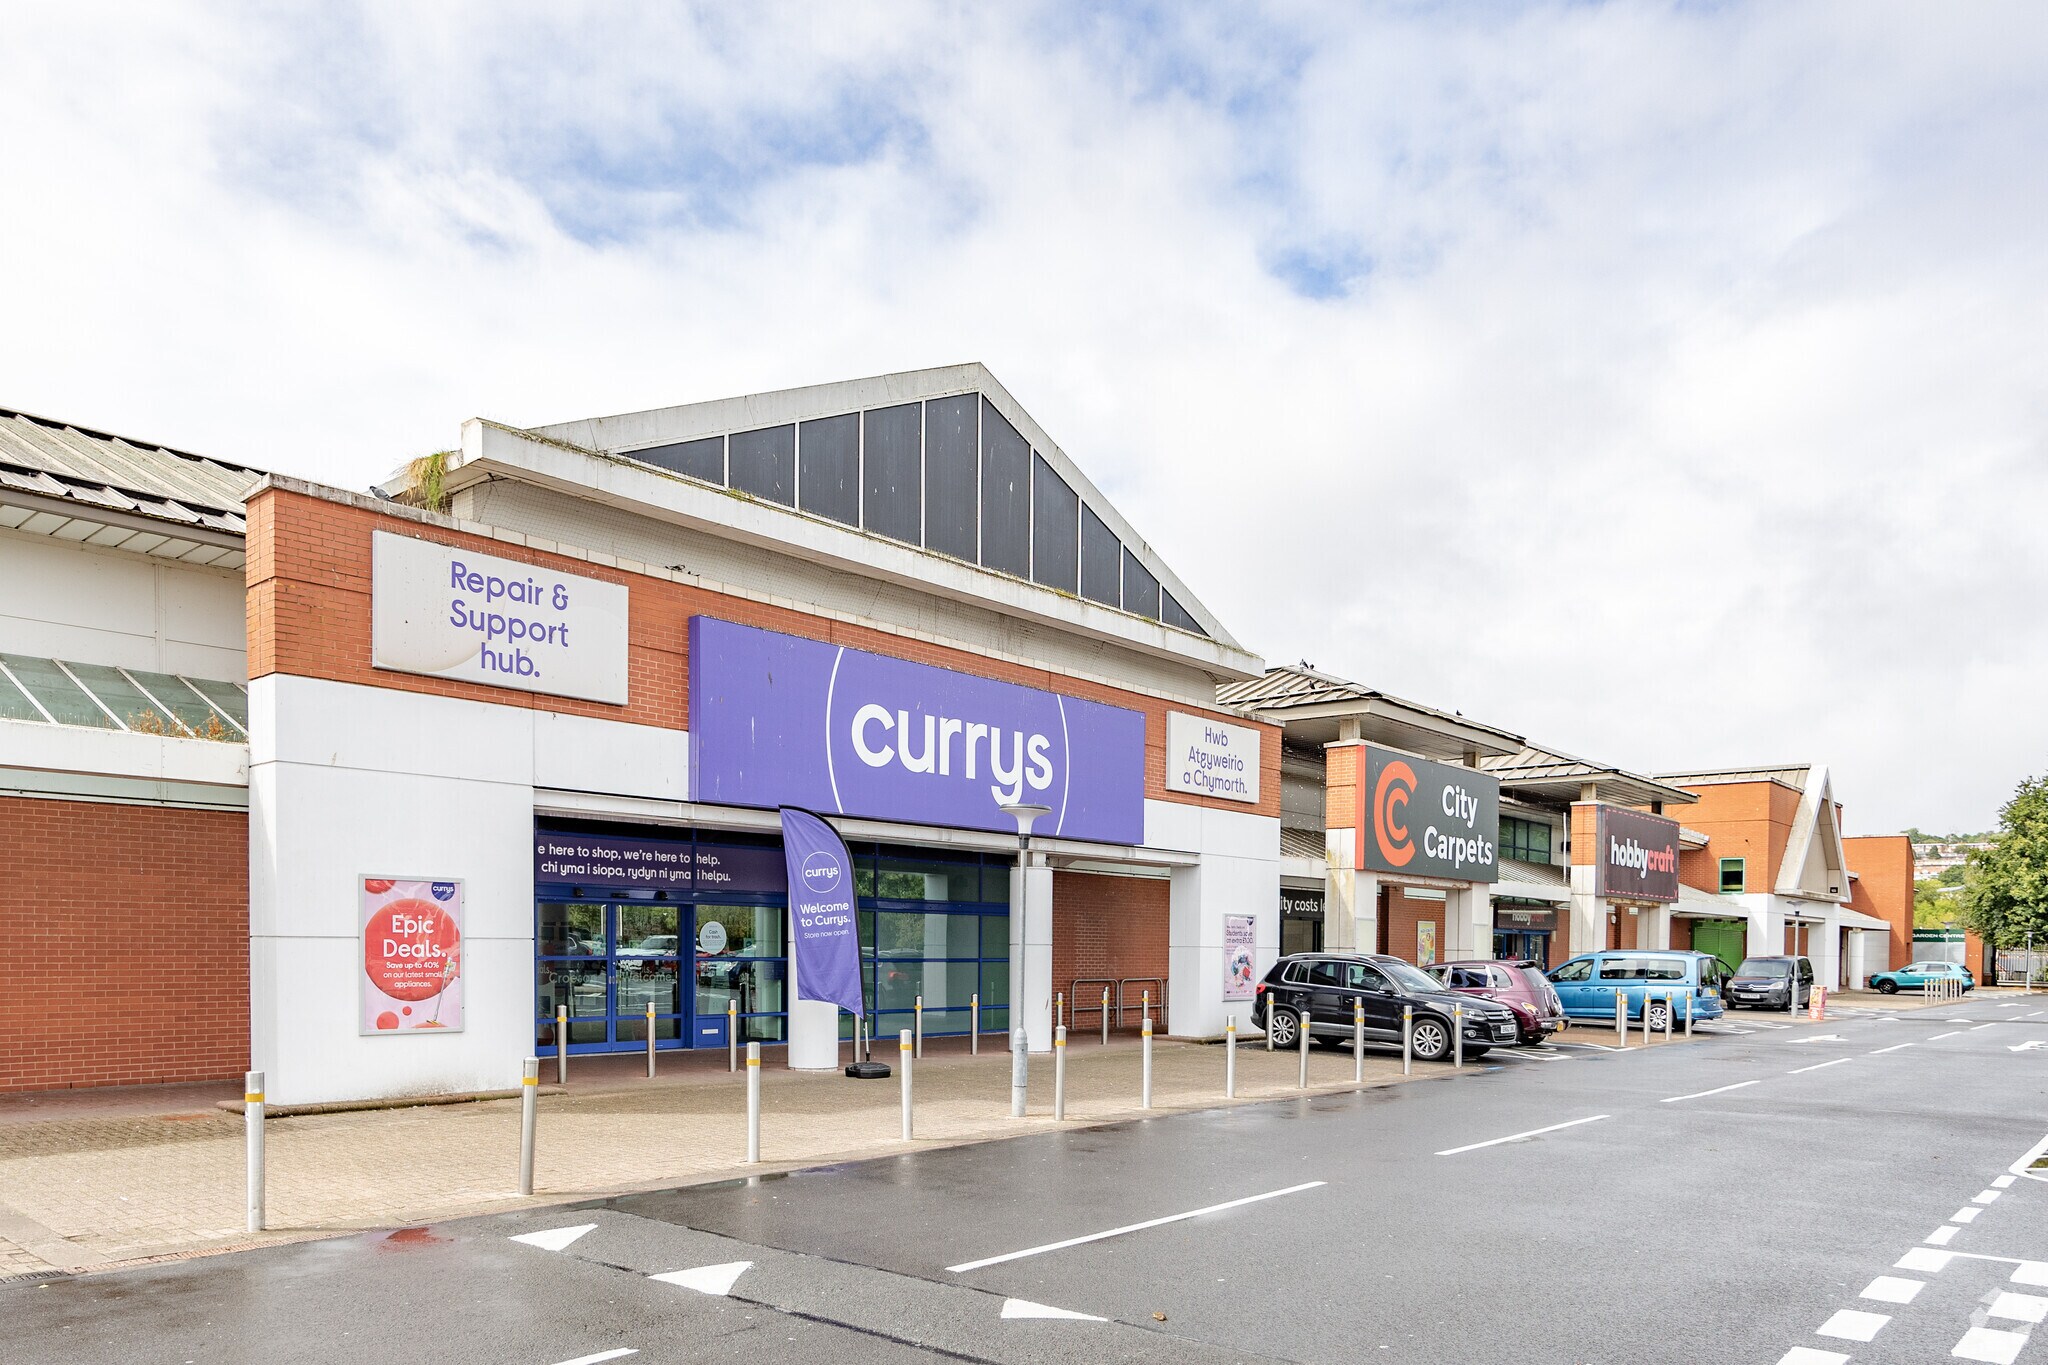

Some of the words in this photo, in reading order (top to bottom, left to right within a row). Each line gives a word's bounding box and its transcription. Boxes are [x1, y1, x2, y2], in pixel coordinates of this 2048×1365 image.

[451, 561, 544, 605] Repair
[552, 583, 569, 611] &
[450, 599, 569, 648] Support
[481, 642, 540, 678] hub.
[1204, 726, 1228, 747] Hwb
[851, 703, 1054, 806] currys
[1188, 745, 1243, 772] Atgyweirio
[1183, 771, 1191, 785] a
[1193, 769, 1248, 794] Chymorth.
[1442, 784, 1478, 829] City
[549, 843, 575, 857] here
[577, 846, 589, 857] to
[591, 847, 622, 862] shop,
[623, 849, 652, 861] we're
[655, 850, 678, 863] here
[679, 853, 691, 863] to
[696, 853, 721, 866] help.
[1424, 825, 1493, 869] Carpets
[1610, 834, 1675, 879] hobbycraft
[541, 861, 558, 873] chi
[560, 865, 585, 877] yma
[587, 863, 591, 874] i
[592, 864, 626, 879] siopa,
[627, 866, 657, 880] rydyn
[659, 868, 668, 879] ni
[669, 870, 691, 882] yma
[696, 869, 700, 880] i
[701, 870, 731, 883] helpu.
[805, 867, 838, 878] currys
[433, 885, 454, 894] currys
[800, 902, 849, 914] Welcome
[1295, 898, 1318, 912] costs
[392, 915, 434, 938] Epic
[801, 917, 812, 927] to
[815, 915, 851, 926] Currys.
[383, 939, 447, 958] Deals.
[404, 962, 414, 971] up
[424, 961, 439, 969] 40%
[405, 970, 424, 979] latest
